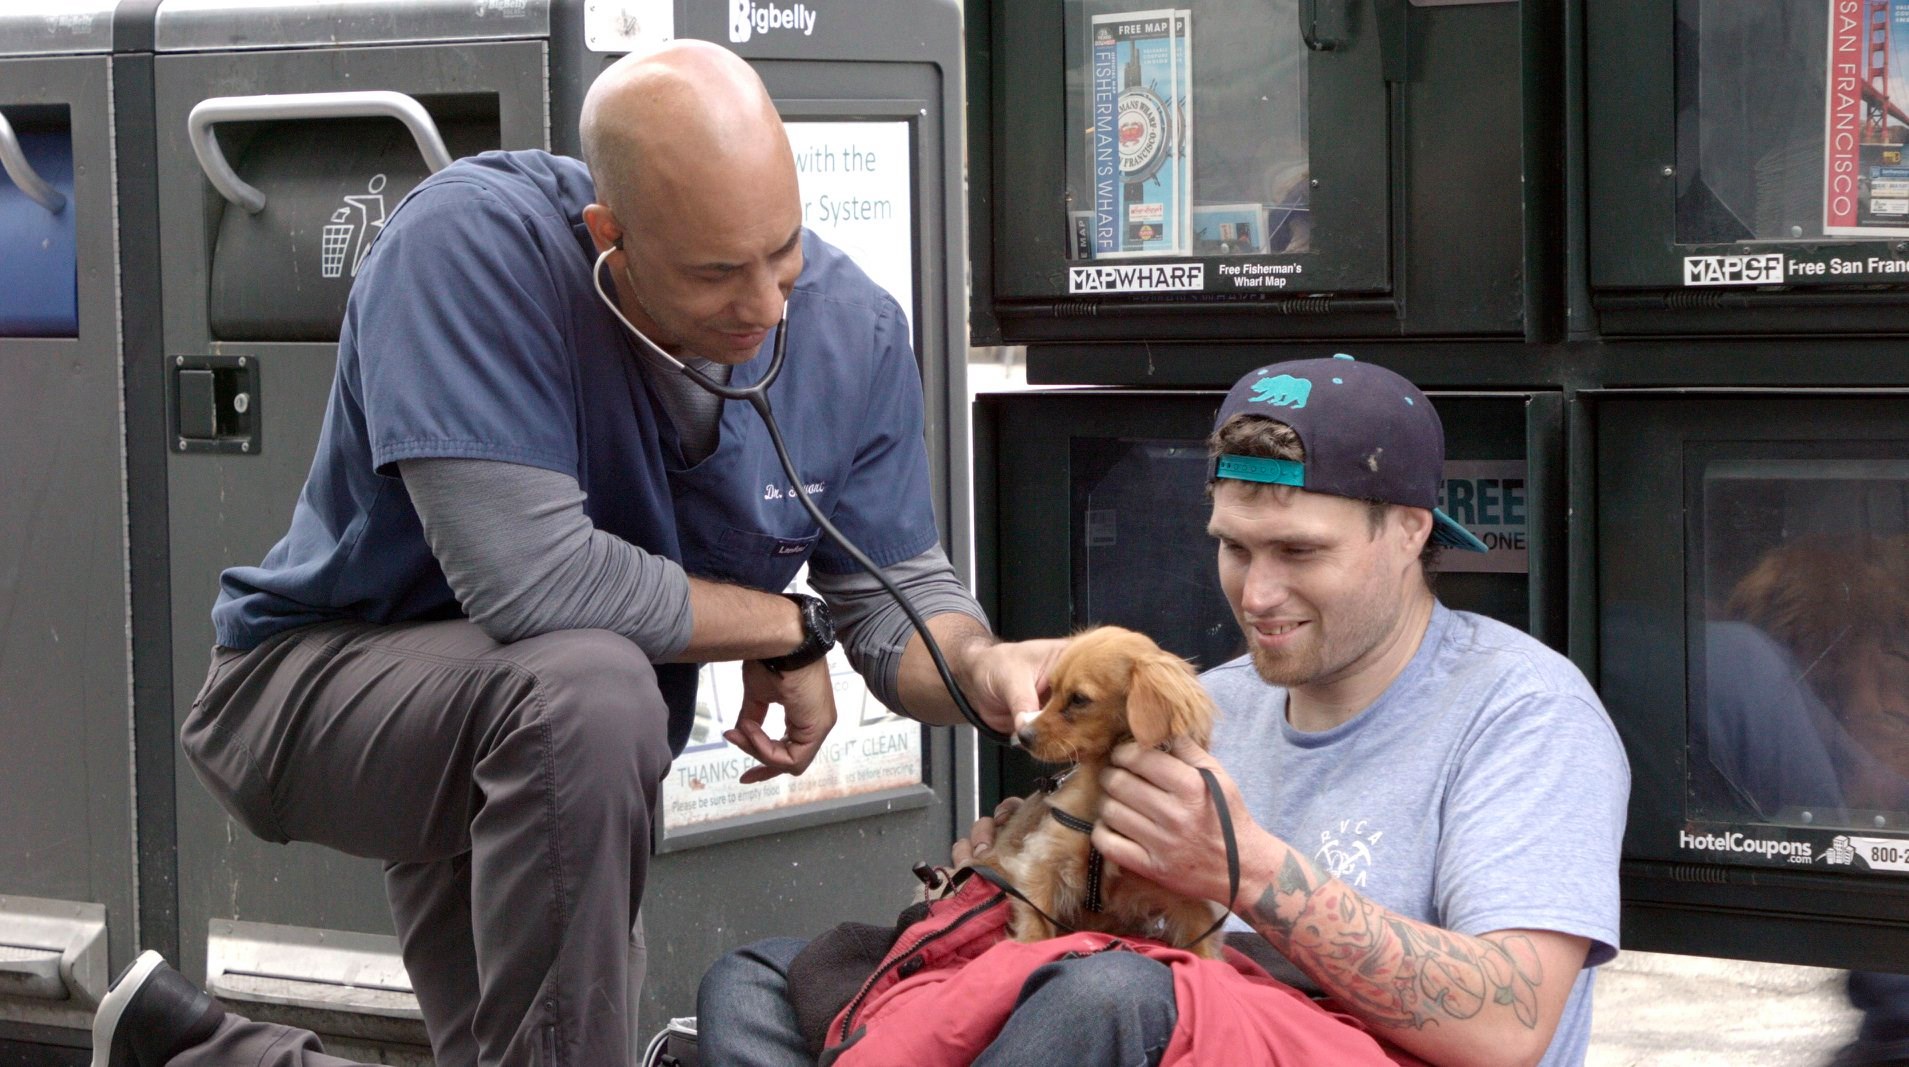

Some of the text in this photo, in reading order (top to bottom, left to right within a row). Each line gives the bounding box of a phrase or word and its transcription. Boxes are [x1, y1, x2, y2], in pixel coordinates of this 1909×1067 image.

[729, 0, 816, 42] Bigbelly
[1118, 25, 1141, 35] FREE
[1145, 22, 1168, 32] MAP
[1096, 52, 1113, 176] FISHERMAN'S
[1832, 1, 1858, 216] SAN FRANCISCO
[842, 144, 876, 172] the
[819, 195, 892, 227] System
[1098, 180, 1113, 248] WHARF
[1072, 267, 1201, 291] MAPWHARF
[1219, 263, 1302, 276] Free Fisherman's
[1687, 257, 1780, 283] MAPSF
[1788, 259, 1826, 275] Free
[1830, 258, 1863, 274] San
[1234, 275, 1286, 288] Wharf Map
[764, 484, 782, 499] Dr.
[1482, 532, 1526, 550] ONE
[862, 731, 908, 757] CLEAN
[677, 759, 739, 787] THANKS
[672, 800, 697, 812] Please
[698, 794, 709, 808] be
[709, 795, 727, 807] sure
[727, 792, 737, 803] to
[737, 788, 761, 802] empty
[1679, 830, 1812, 859] HotelCoupons
